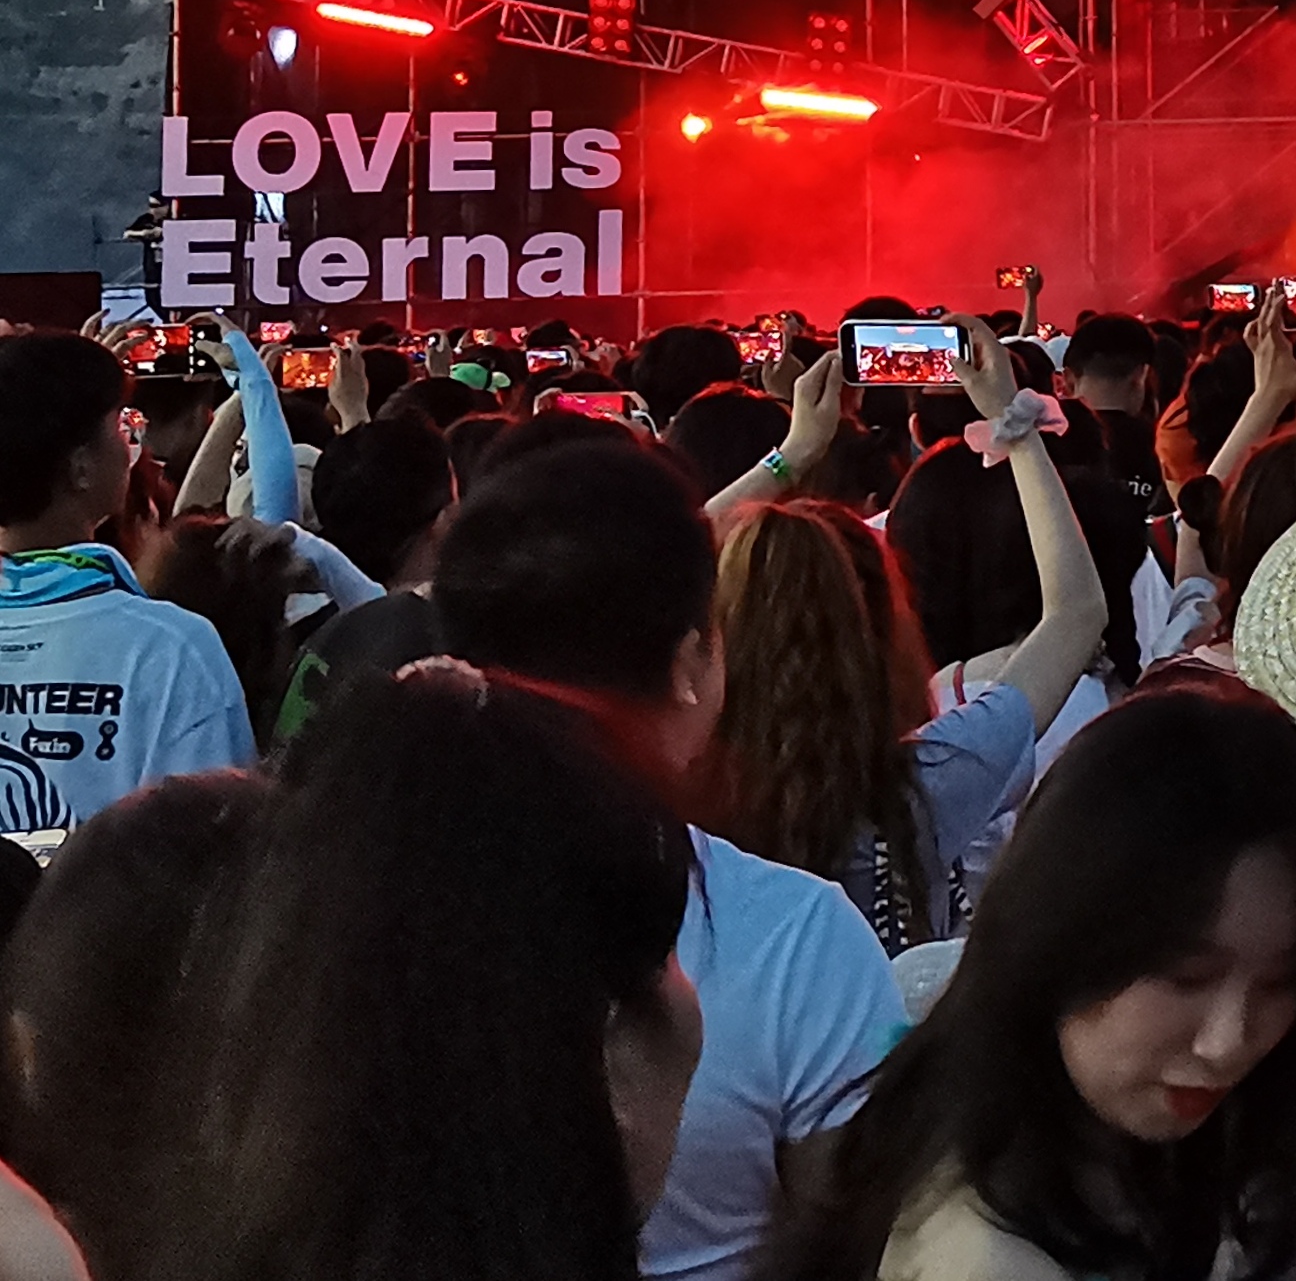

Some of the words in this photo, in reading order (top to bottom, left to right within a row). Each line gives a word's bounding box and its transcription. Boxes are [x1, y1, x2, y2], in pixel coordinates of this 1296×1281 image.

[161, 111, 498, 197] LOVE
[529, 110, 622, 190] is
[161, 209, 624, 307] Eternal
[0, 682, 124, 716] NTEER
